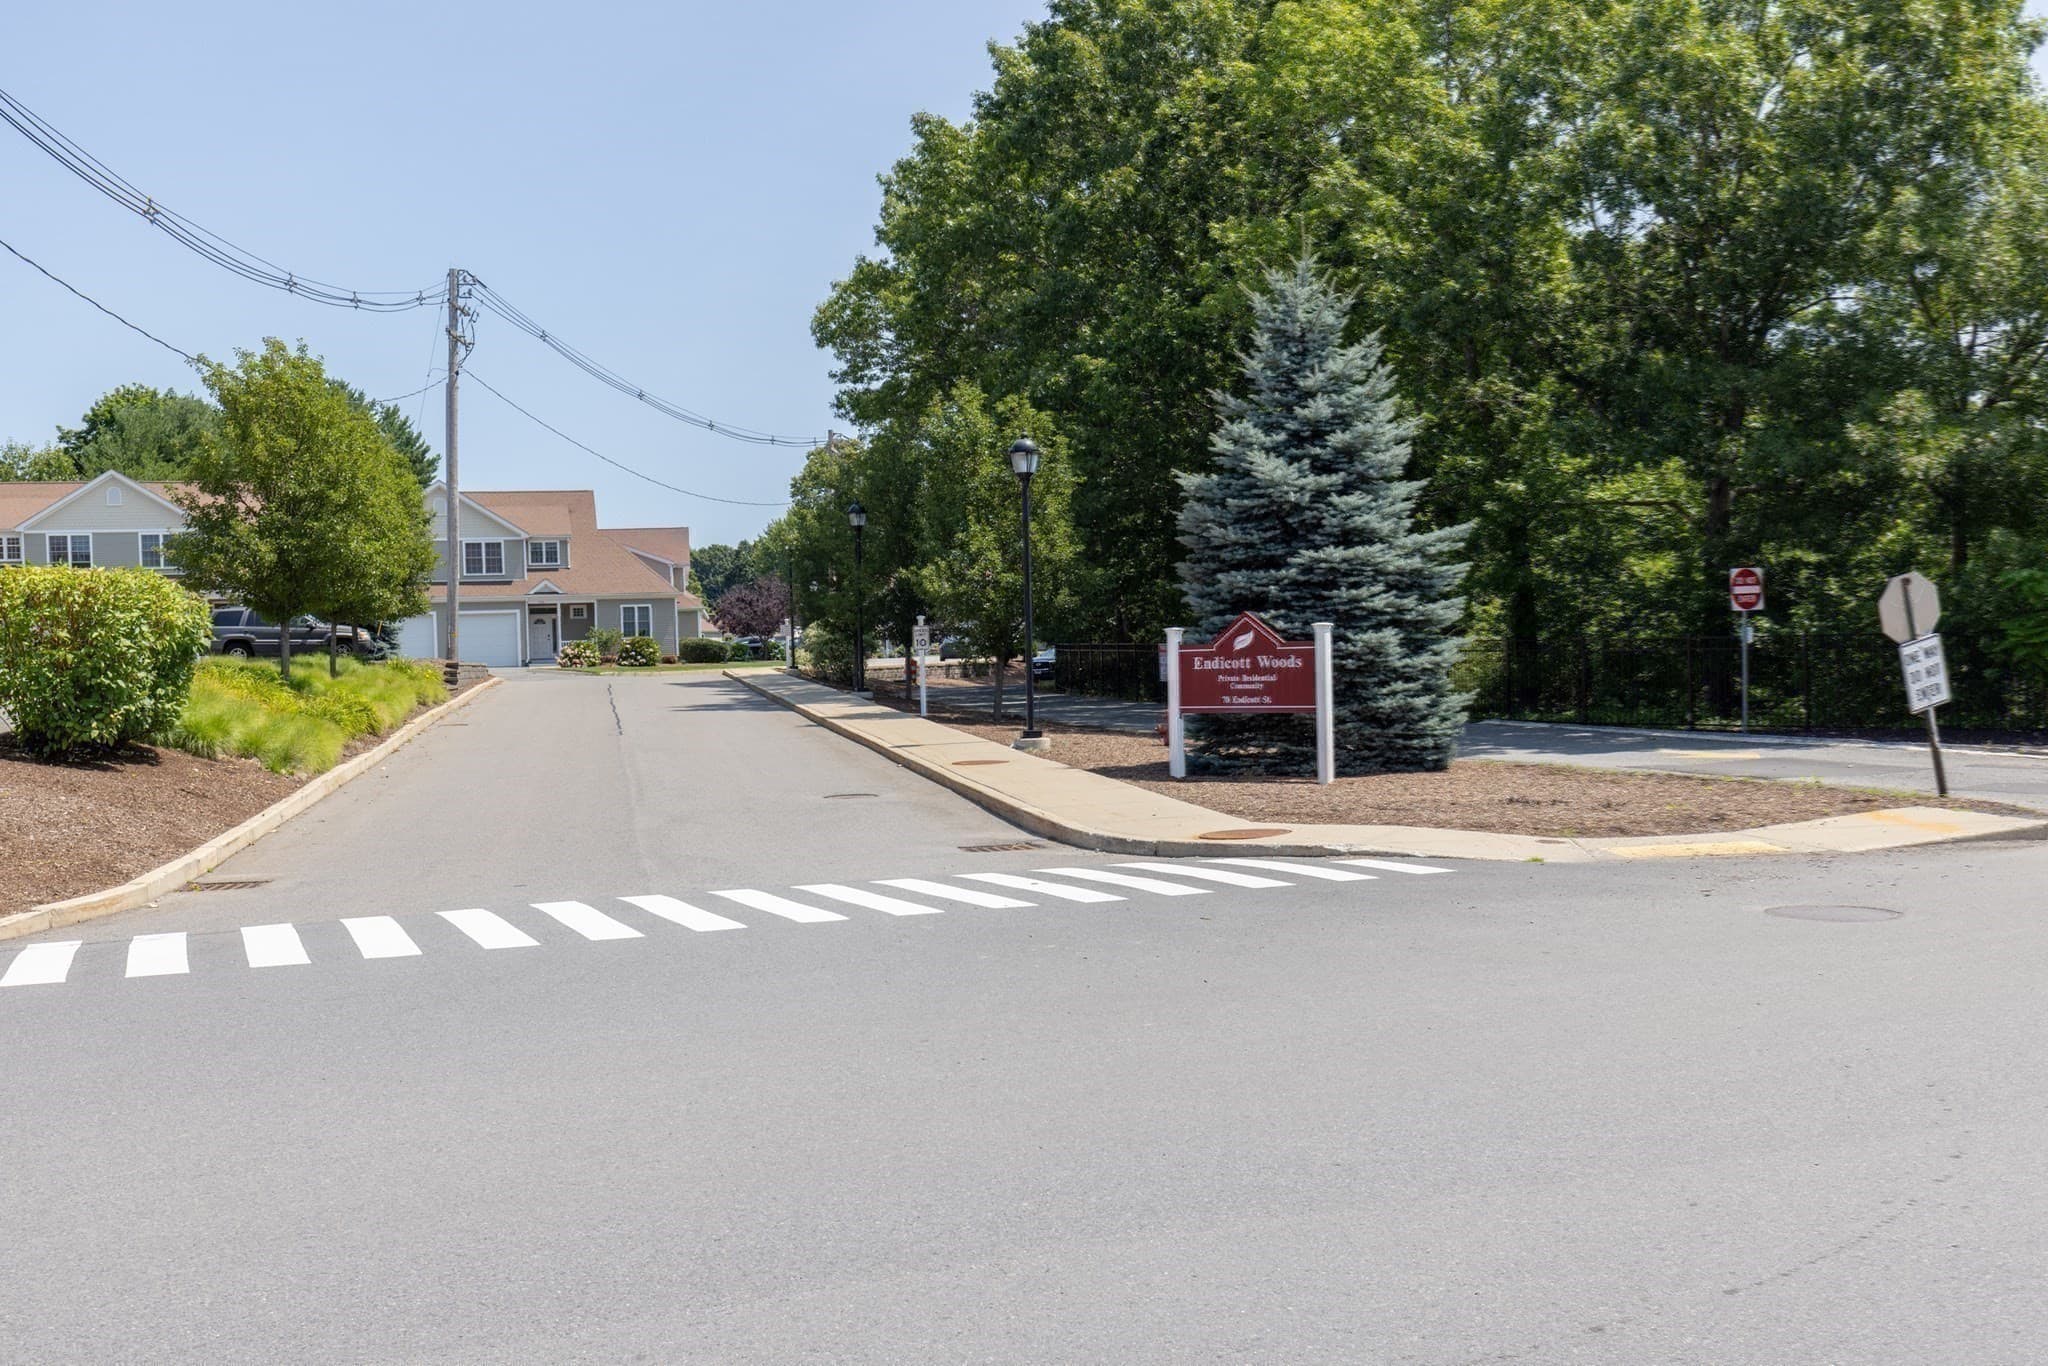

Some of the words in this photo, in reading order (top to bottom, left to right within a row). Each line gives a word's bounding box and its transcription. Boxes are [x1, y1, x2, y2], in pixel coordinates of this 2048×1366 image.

[916, 638, 927, 647] 10
[1193, 656, 1251, 670] Endicott
[1257, 654, 1302, 669] Woods
[1217, 674, 1240, 682] Private
